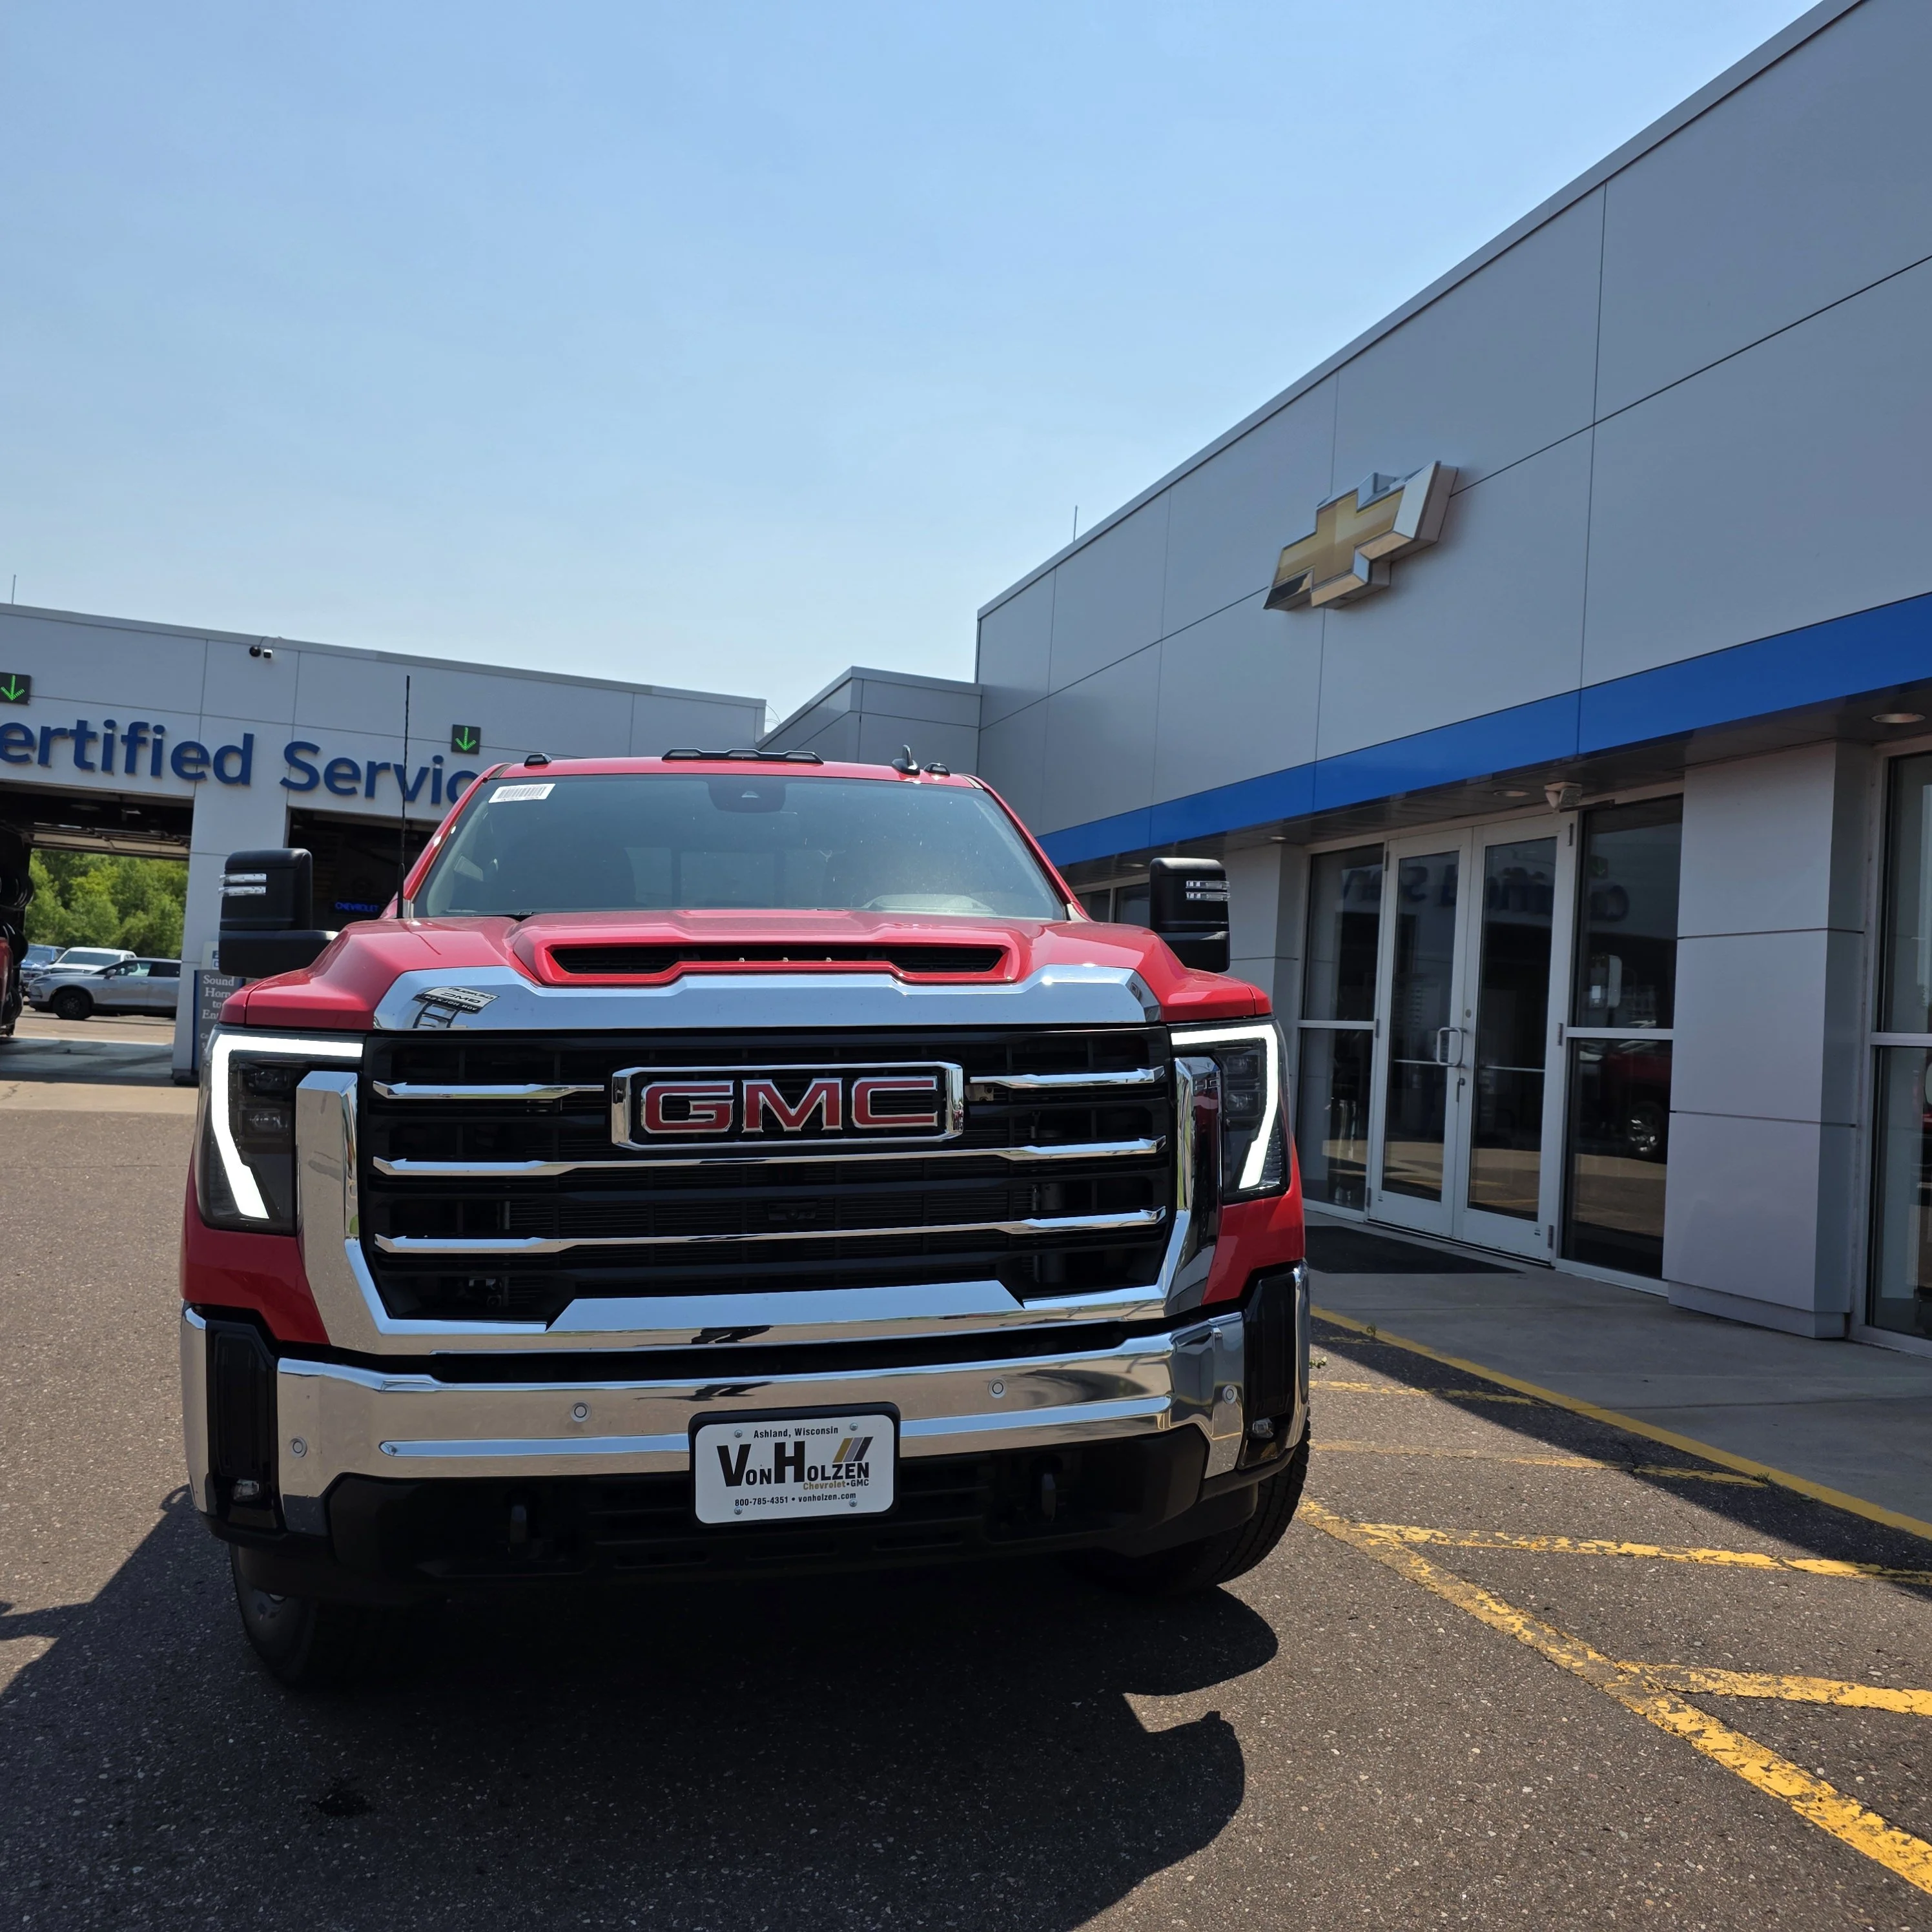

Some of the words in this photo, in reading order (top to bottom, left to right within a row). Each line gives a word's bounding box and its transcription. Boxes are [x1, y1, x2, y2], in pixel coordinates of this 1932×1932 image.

[0, 719, 254, 786] ertified
[280, 741, 480, 805] Servic
[203, 974, 234, 986] Sound
[641, 1076, 938, 1134] GMC
[753, 1428, 792, 1439] Ashland,
[794, 1426, 839, 1436] Wisconsin
[734, 1495, 788, 1507] 800-785-4351
[798, 1492, 857, 1503] vonholzen.com
